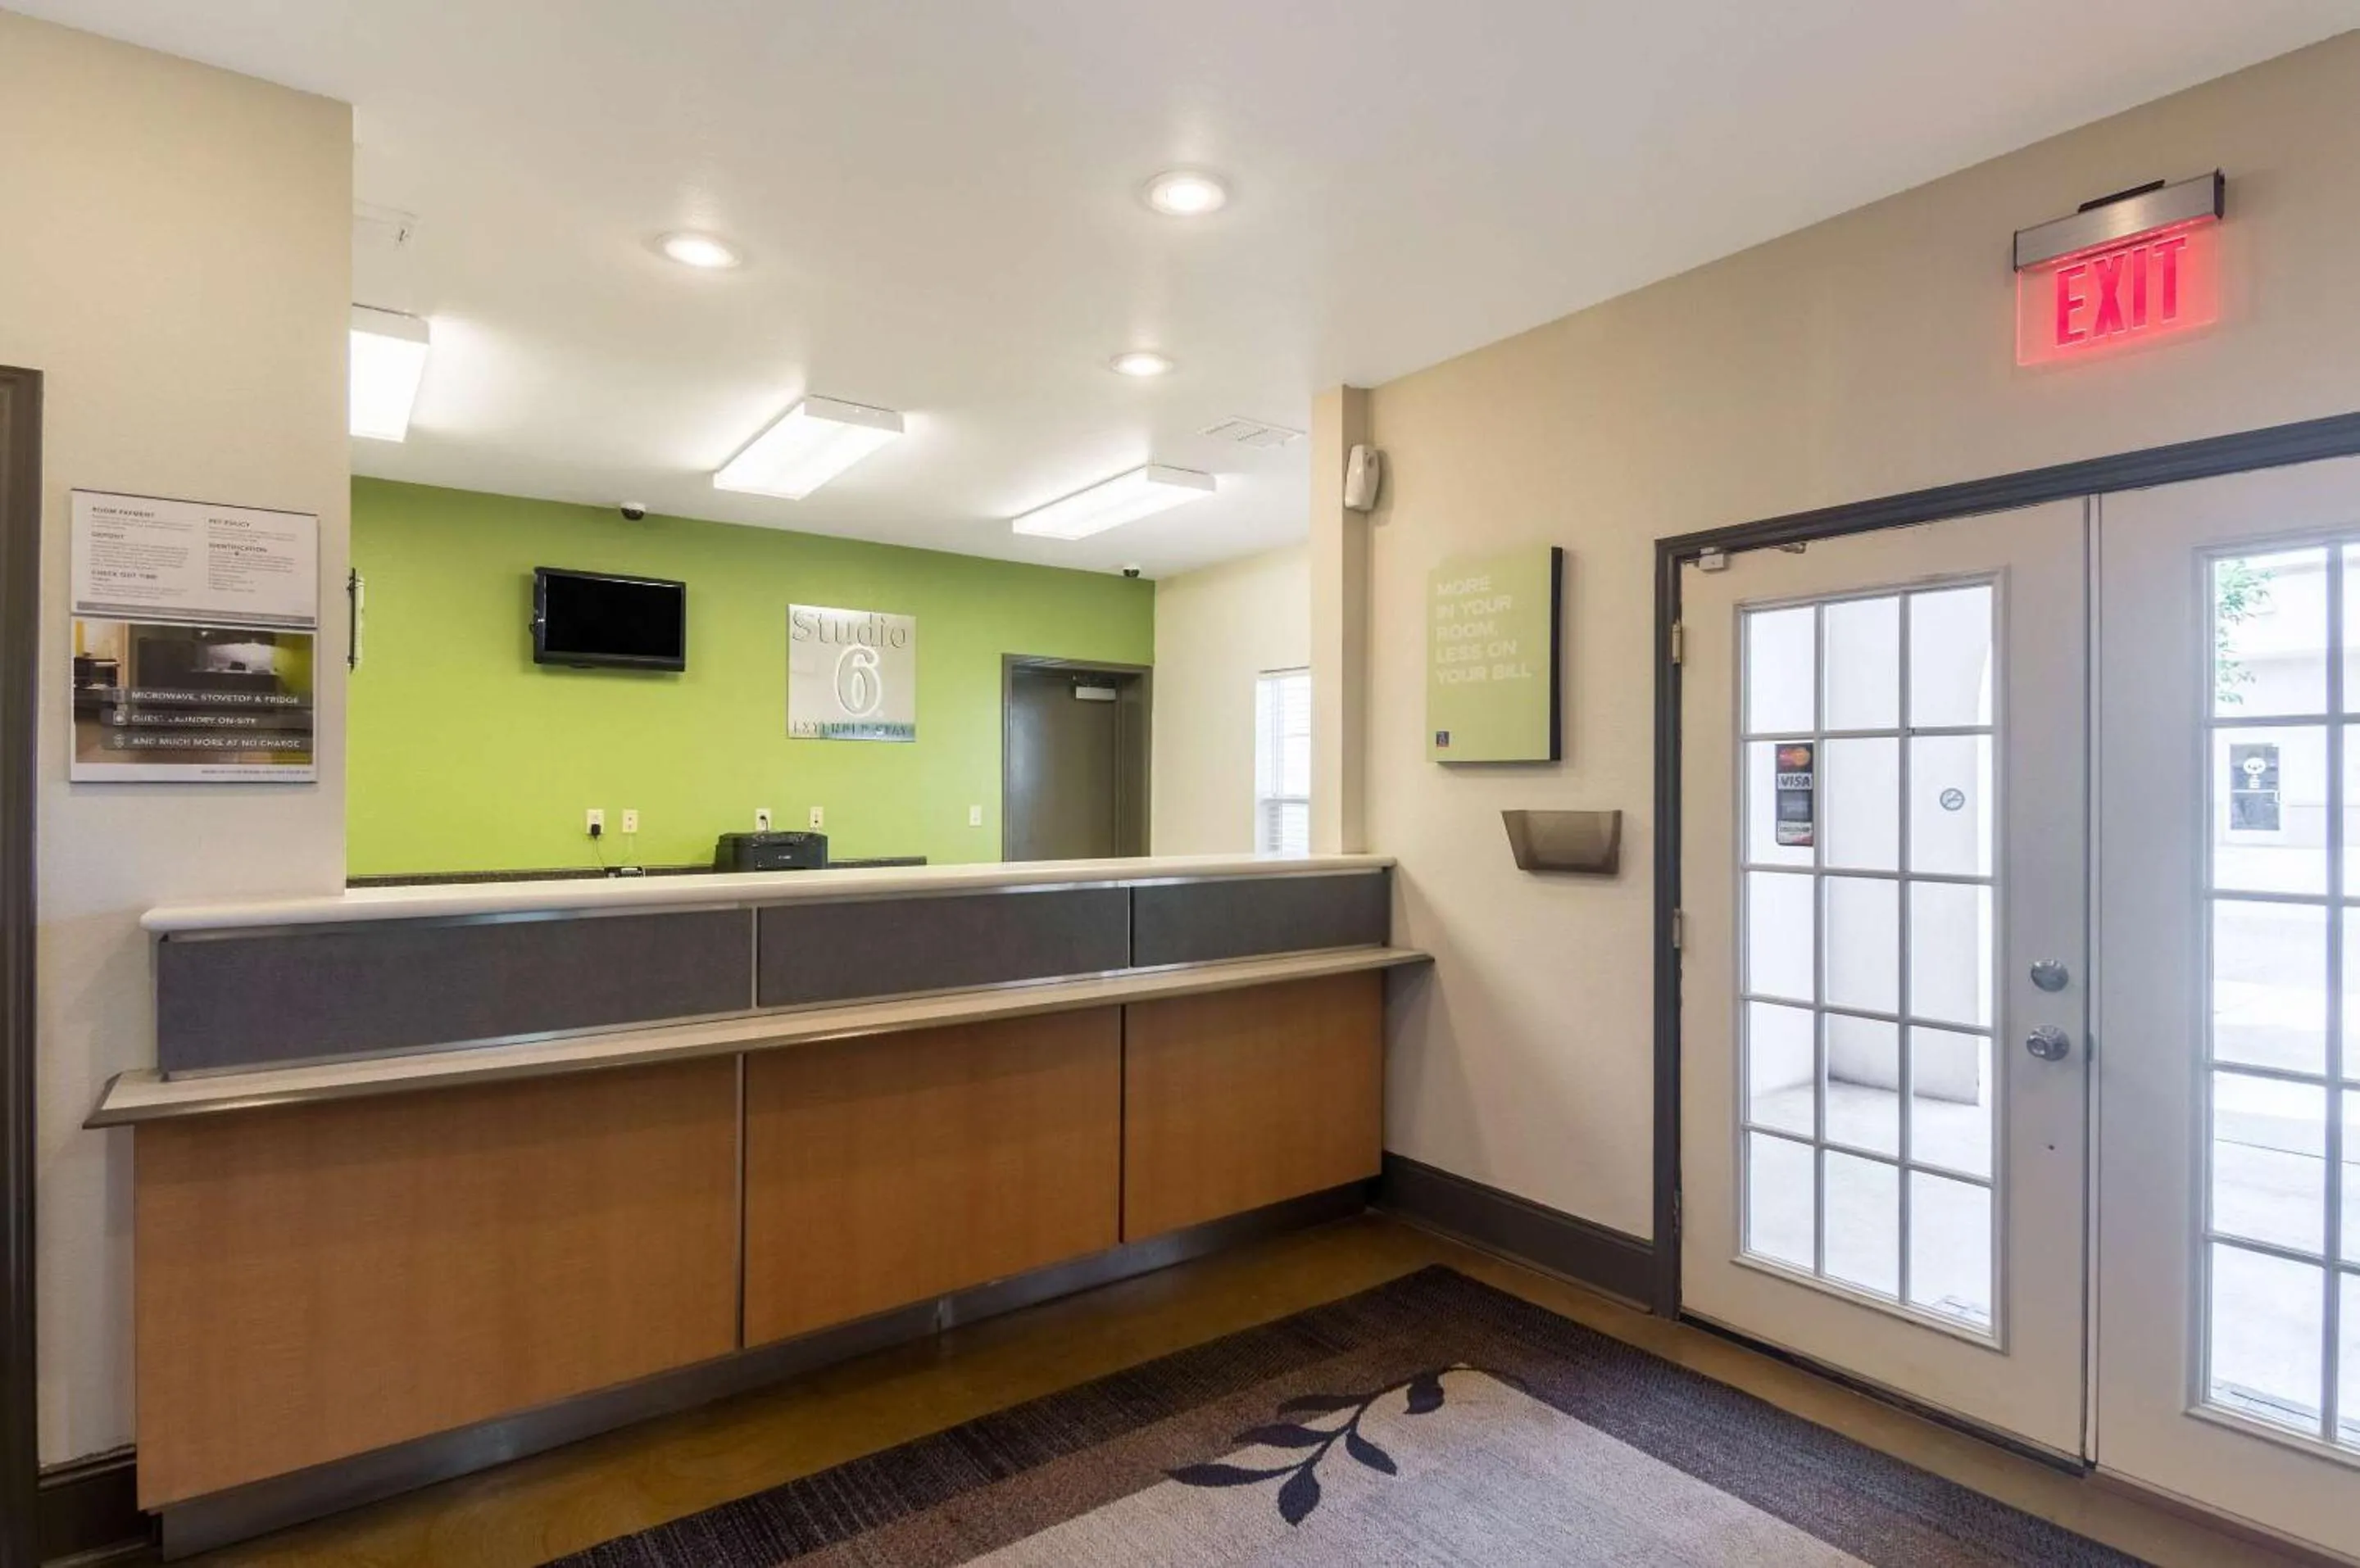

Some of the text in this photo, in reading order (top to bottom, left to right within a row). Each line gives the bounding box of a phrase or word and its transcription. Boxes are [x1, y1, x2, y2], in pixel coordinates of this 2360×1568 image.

[2055, 234, 2187, 348] EXIT
[1436, 575, 1492, 596] MORE
[1436, 594, 1513, 619] IN YOUR
[792, 610, 906, 649] Studio
[1436, 620, 1499, 642] ROOM,
[1436, 638, 1518, 664] LESS ON
[835, 643, 882, 718] 6
[1436, 662, 1532, 685] YOUR BILL
[201, 694, 252, 703] STOVETOP
[159, 737, 189, 746] MUCH
[193, 738, 224, 747] MORE
[1780, 774, 1810, 787] VISA
